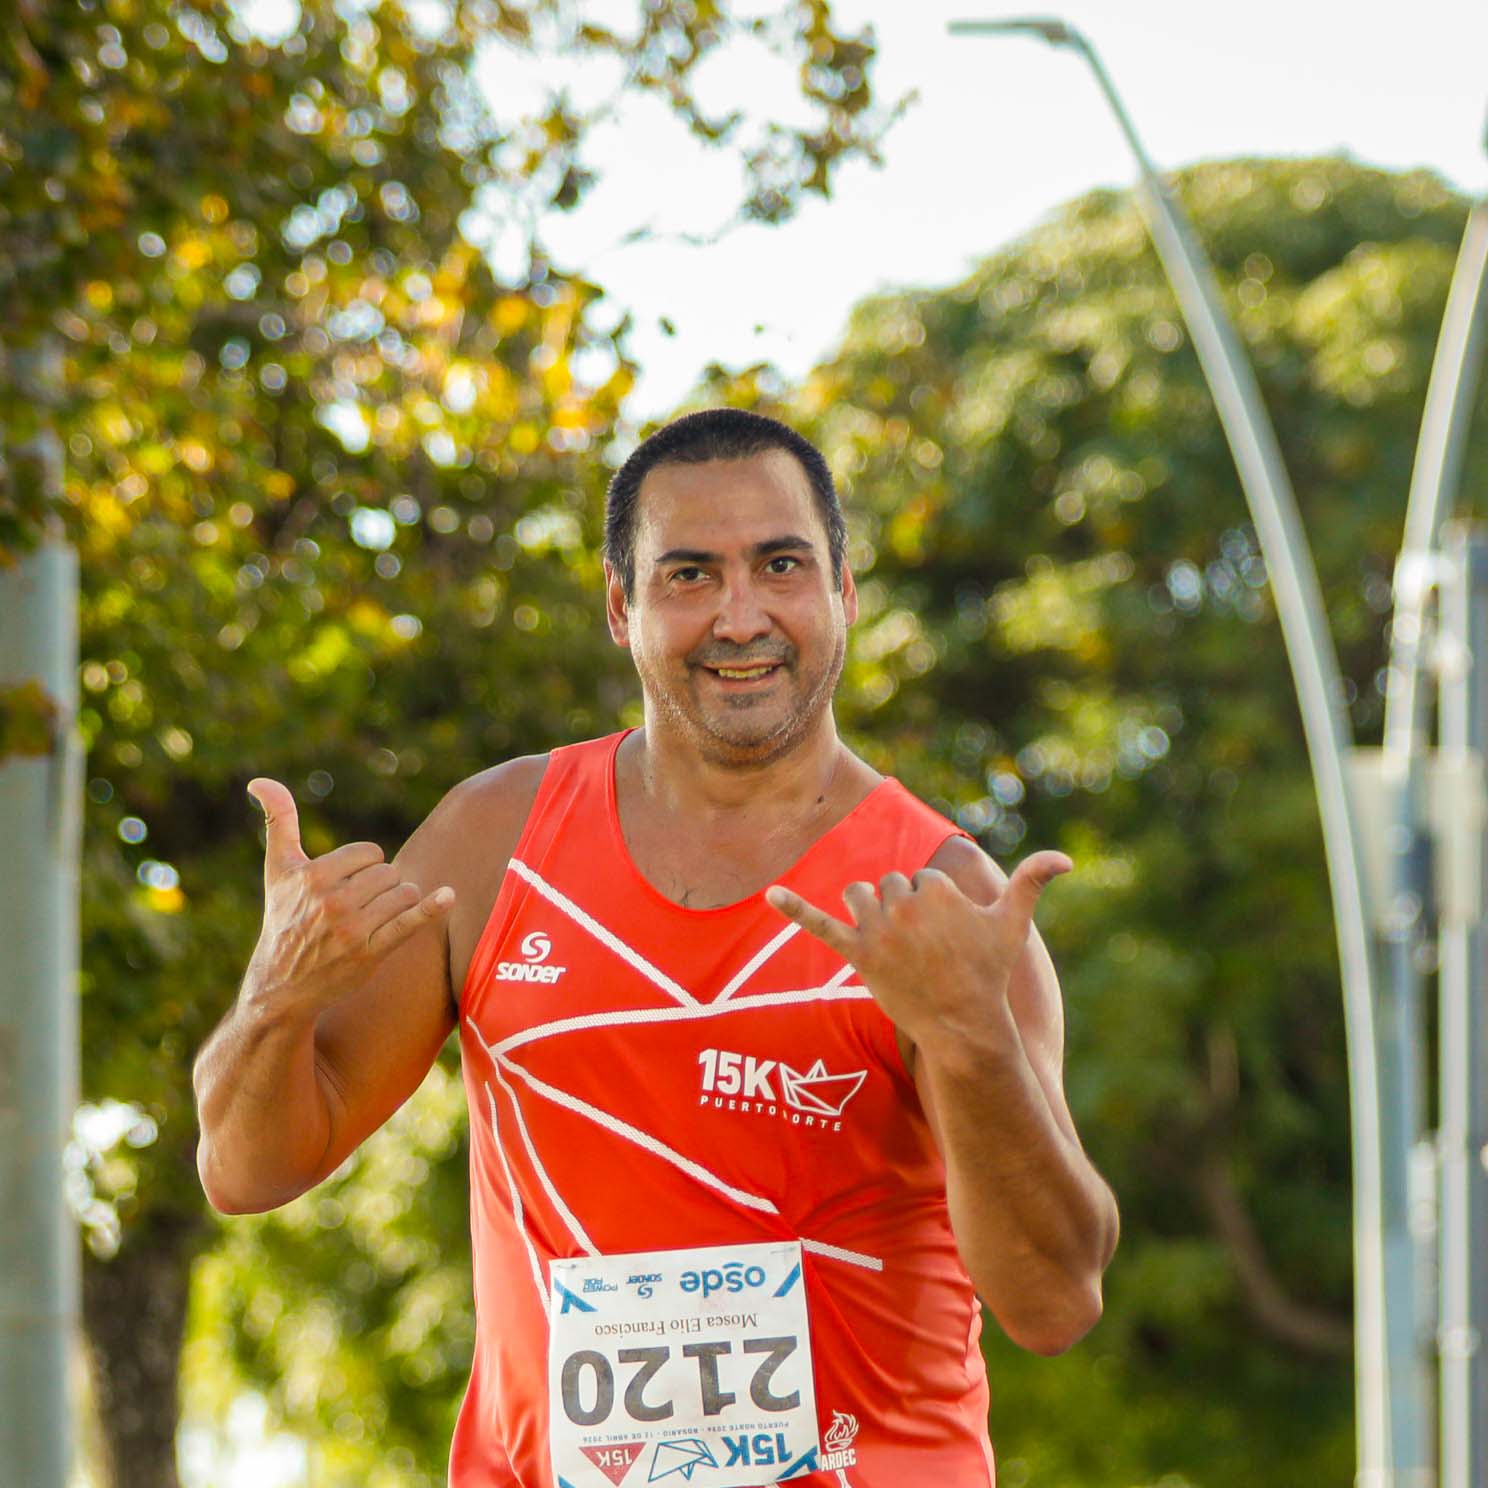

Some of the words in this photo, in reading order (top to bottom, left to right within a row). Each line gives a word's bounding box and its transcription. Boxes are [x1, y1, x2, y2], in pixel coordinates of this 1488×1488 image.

[698, 1048, 777, 1101] 15K
[700, 1096, 777, 1116] PUERTO
[680, 1262, 766, 1298] osde
[594, 1320, 666, 1338] Francisco
[671, 1318, 702, 1334] Elio
[707, 1313, 758, 1329] Mosca
[561, 1336, 801, 1426] 2120
[597, 1448, 633, 1467] 15K
[721, 1433, 793, 1467] 15K
[821, 1449, 857, 1472] ARDEC
